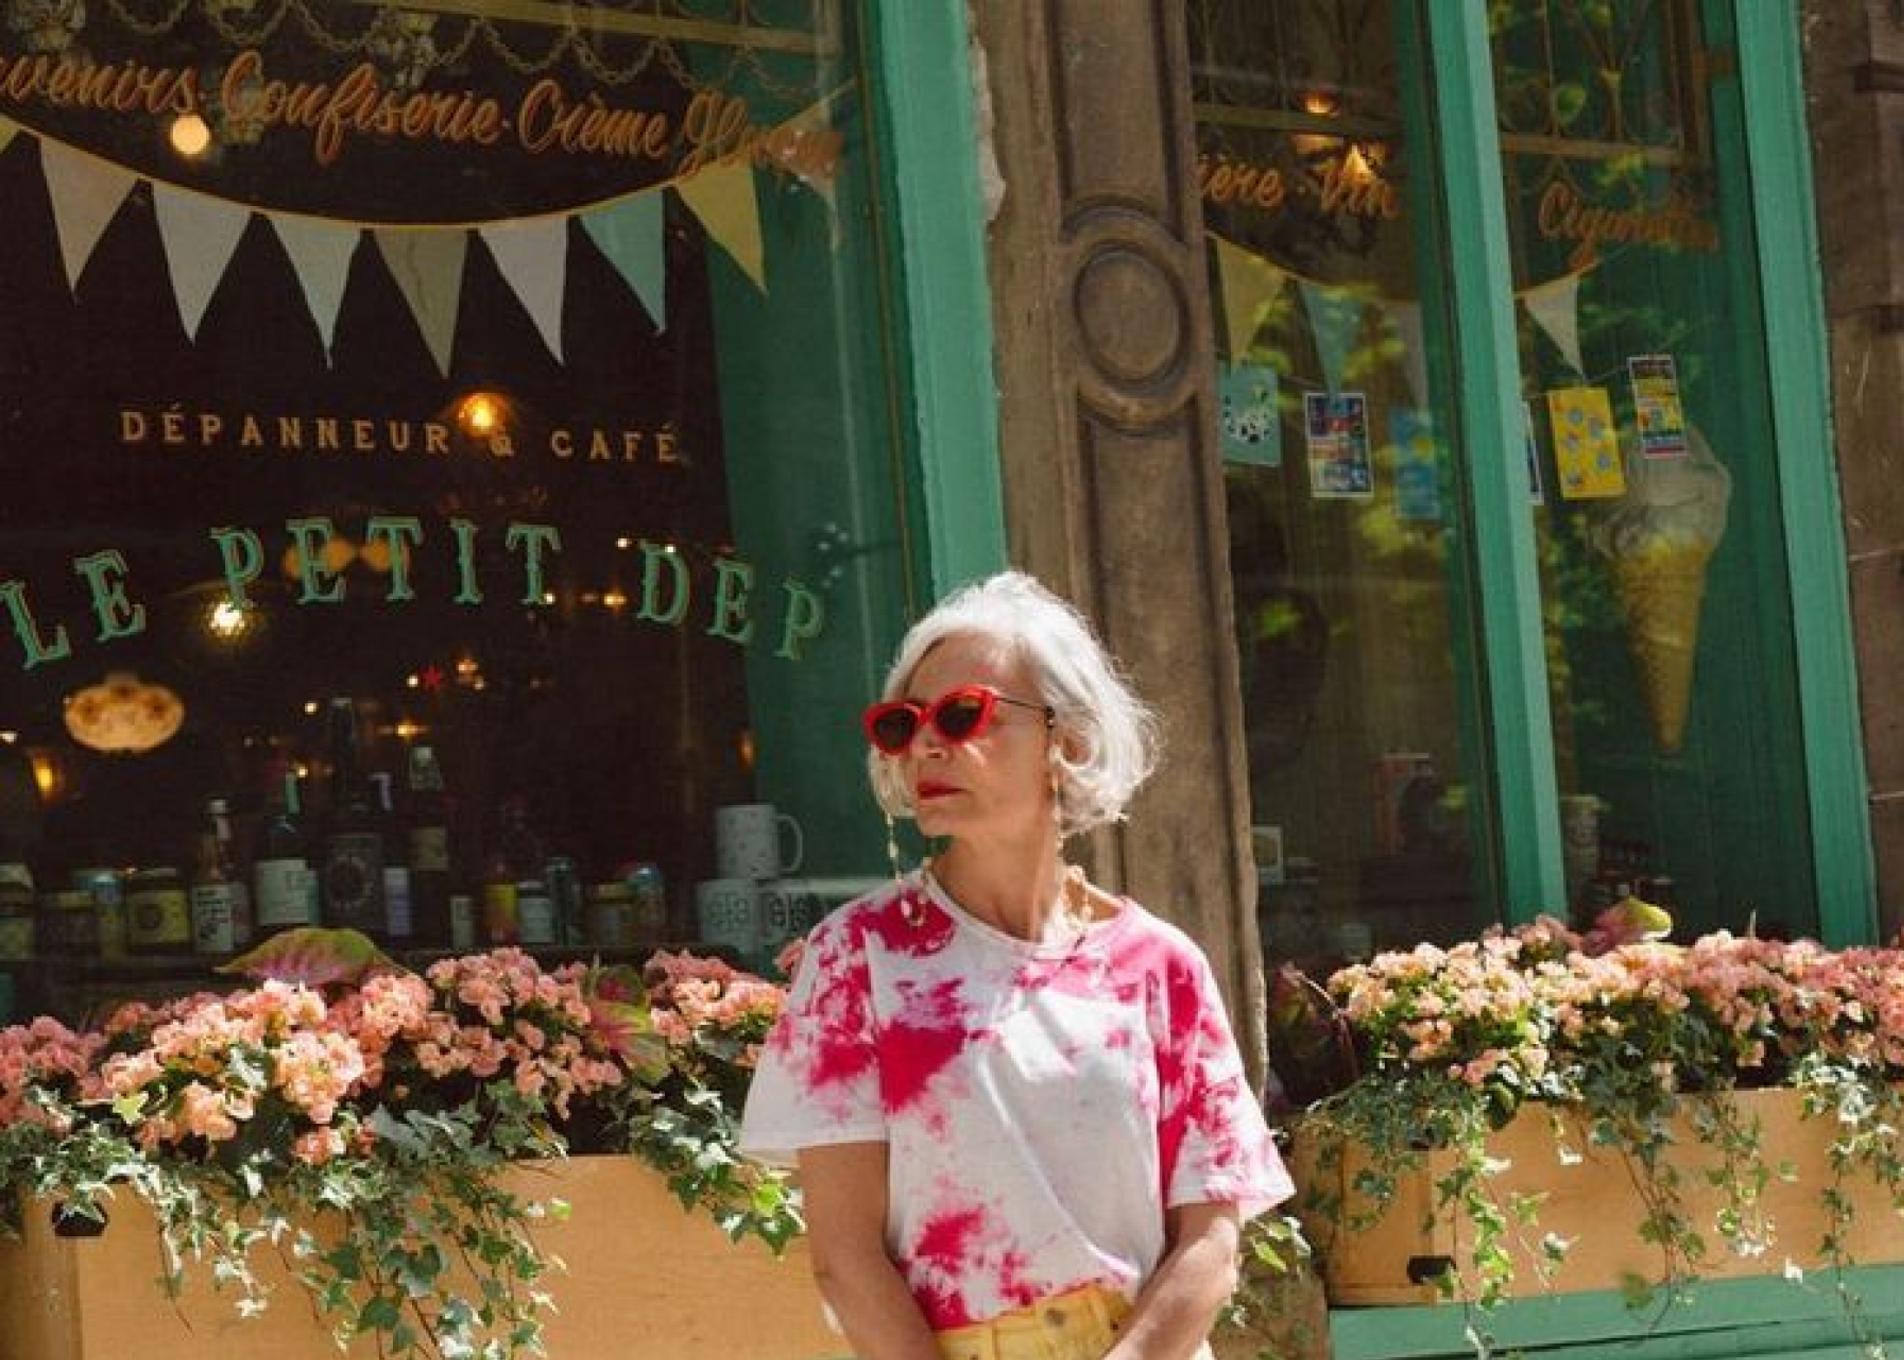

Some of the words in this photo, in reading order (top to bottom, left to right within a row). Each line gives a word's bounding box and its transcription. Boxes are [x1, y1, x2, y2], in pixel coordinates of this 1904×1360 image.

[0, 54, 199, 113] venirs
[222, 49, 499, 165] Confiserie
[519, 79, 669, 158] Crème
[121, 402, 449, 455] DÉPANNEUR
[489, 427, 515, 458] &
[550, 425, 681, 463] CAFÉ
[0, 548, 147, 670] LE
[208, 514, 562, 611] PETIT
[636, 538, 824, 660] DEP
